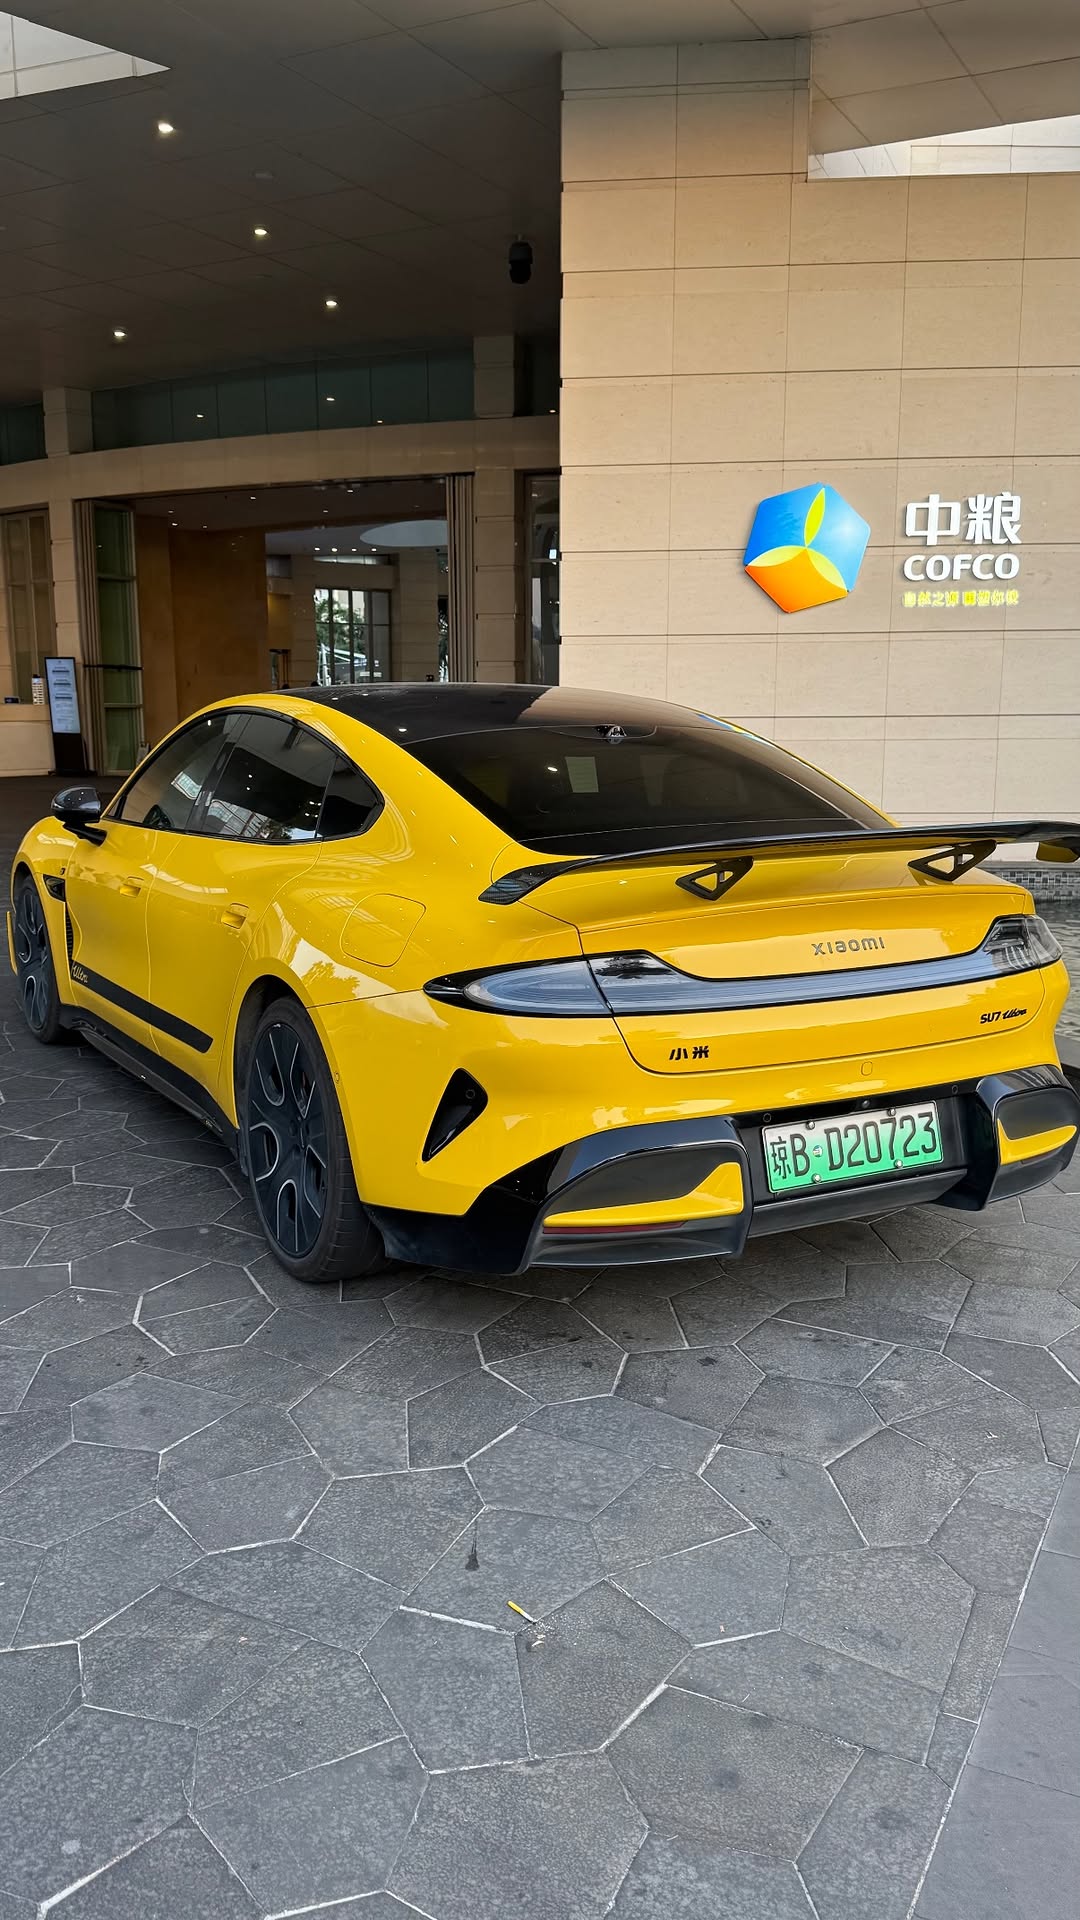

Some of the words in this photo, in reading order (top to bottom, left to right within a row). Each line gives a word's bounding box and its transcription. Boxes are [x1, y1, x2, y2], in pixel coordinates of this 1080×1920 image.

[905, 492, 1022, 546] 中粮
[903, 553, 1020, 582] COFCO
[980, 1011, 1001, 1024] SU7
[669, 1045, 709, 1061] 小米
